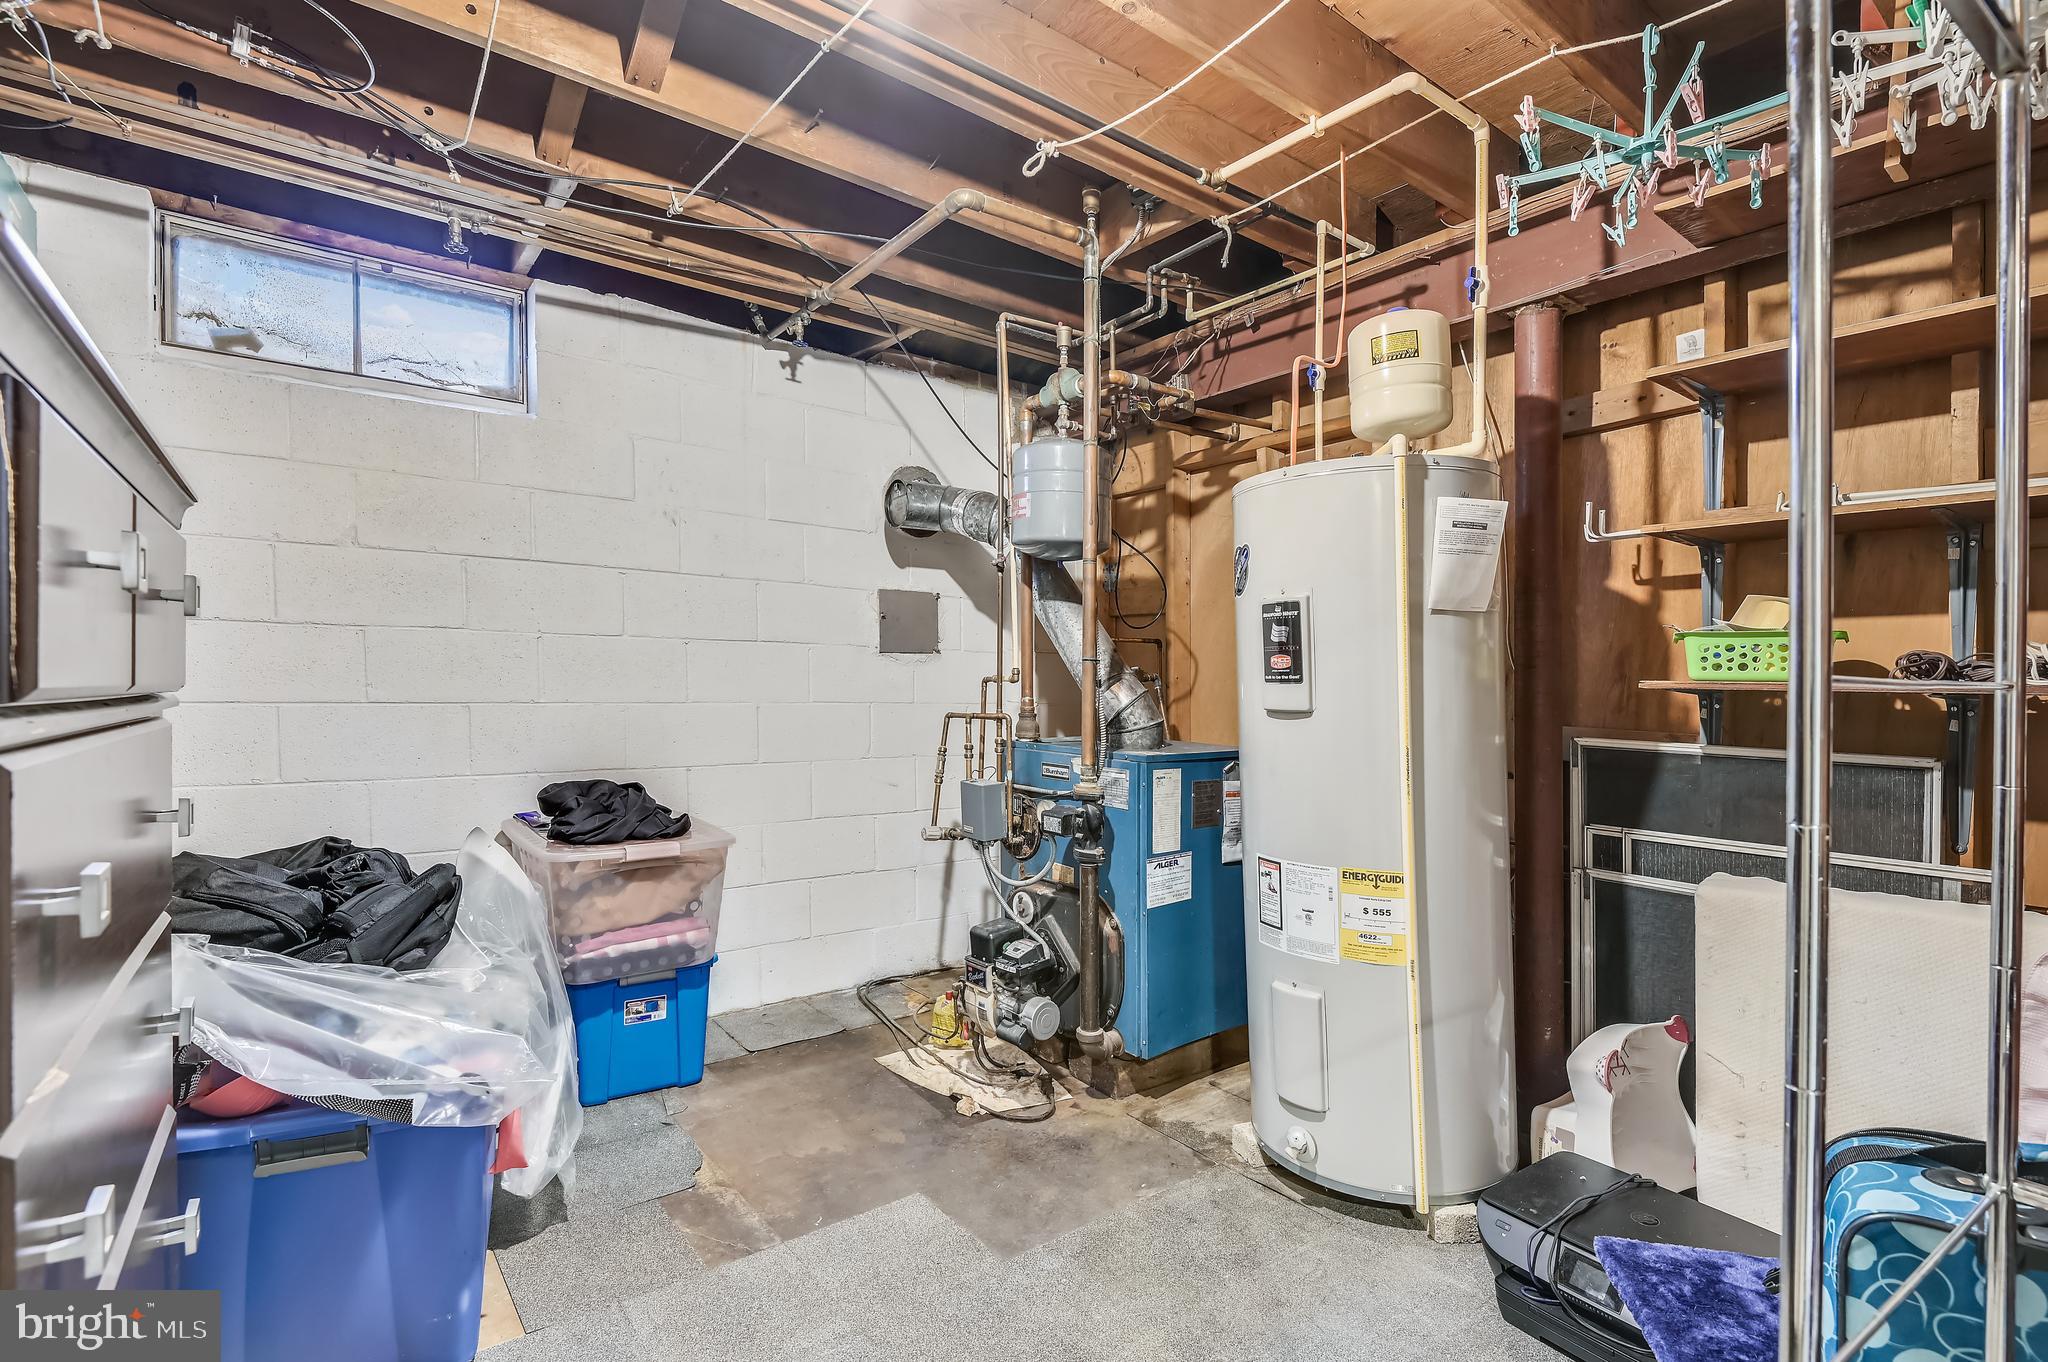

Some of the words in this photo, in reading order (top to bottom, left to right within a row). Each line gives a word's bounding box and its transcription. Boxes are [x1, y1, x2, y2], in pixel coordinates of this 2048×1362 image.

[1153, 859, 1179, 870] ALGER
[1342, 870, 1404, 885] ENERGYGUID
[1362, 907, 1369, 915] $
[1372, 908, 1392, 917] 555
